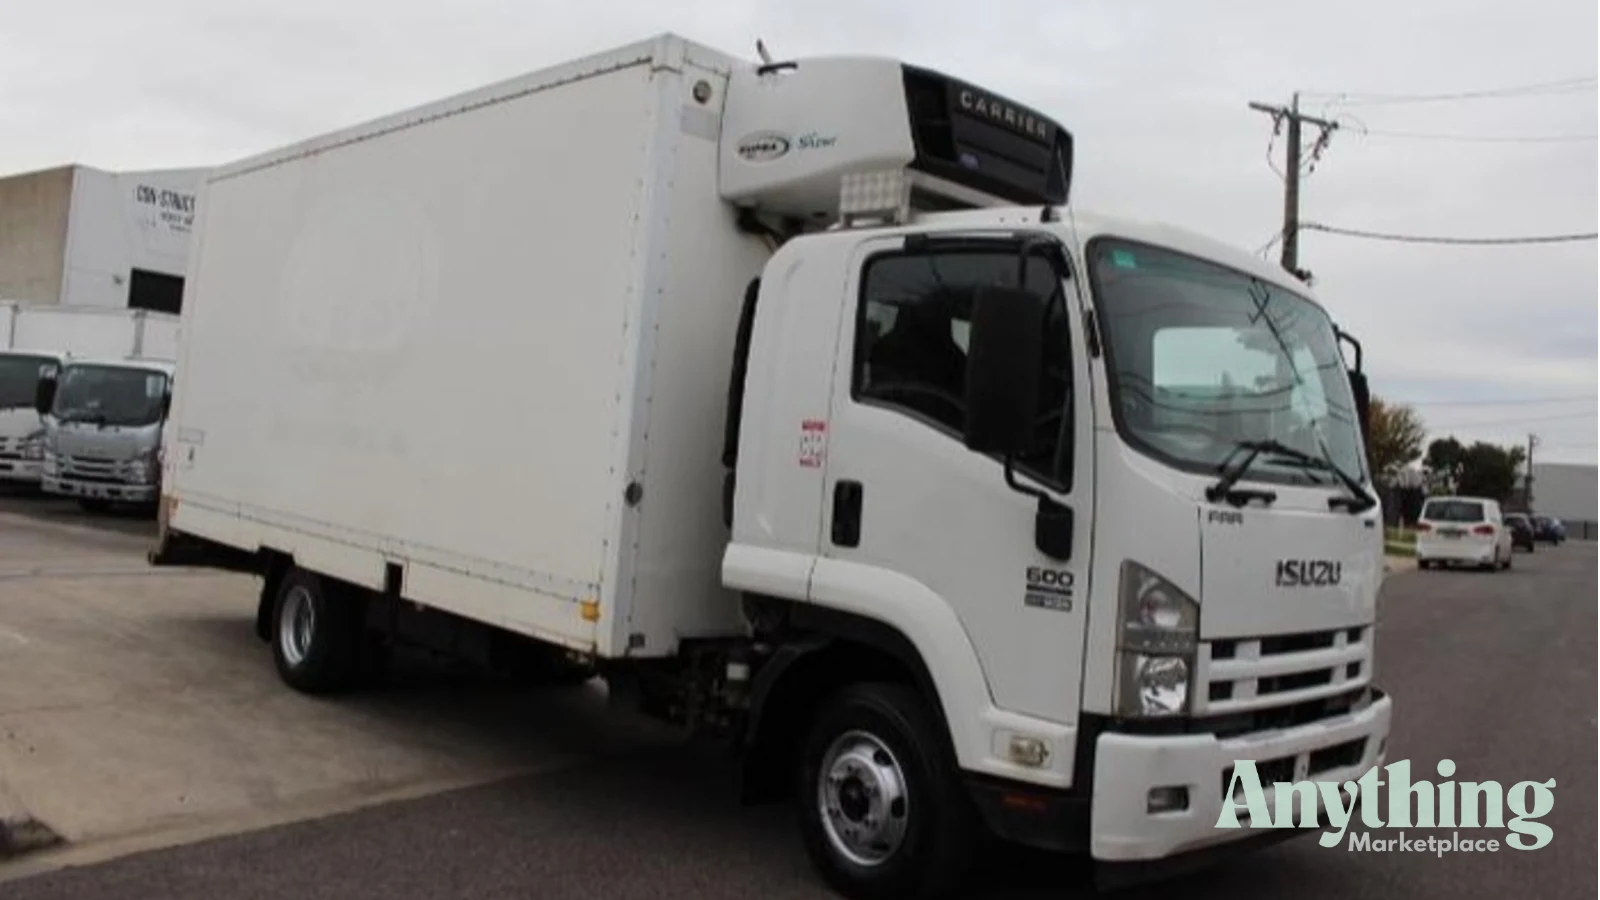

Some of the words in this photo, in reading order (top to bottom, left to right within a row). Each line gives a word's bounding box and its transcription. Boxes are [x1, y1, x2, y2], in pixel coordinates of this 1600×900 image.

[961, 90, 1046, 139] CARRIER
[1026, 567, 1074, 587] 600
[1275, 559, 1342, 587] ISUZU
